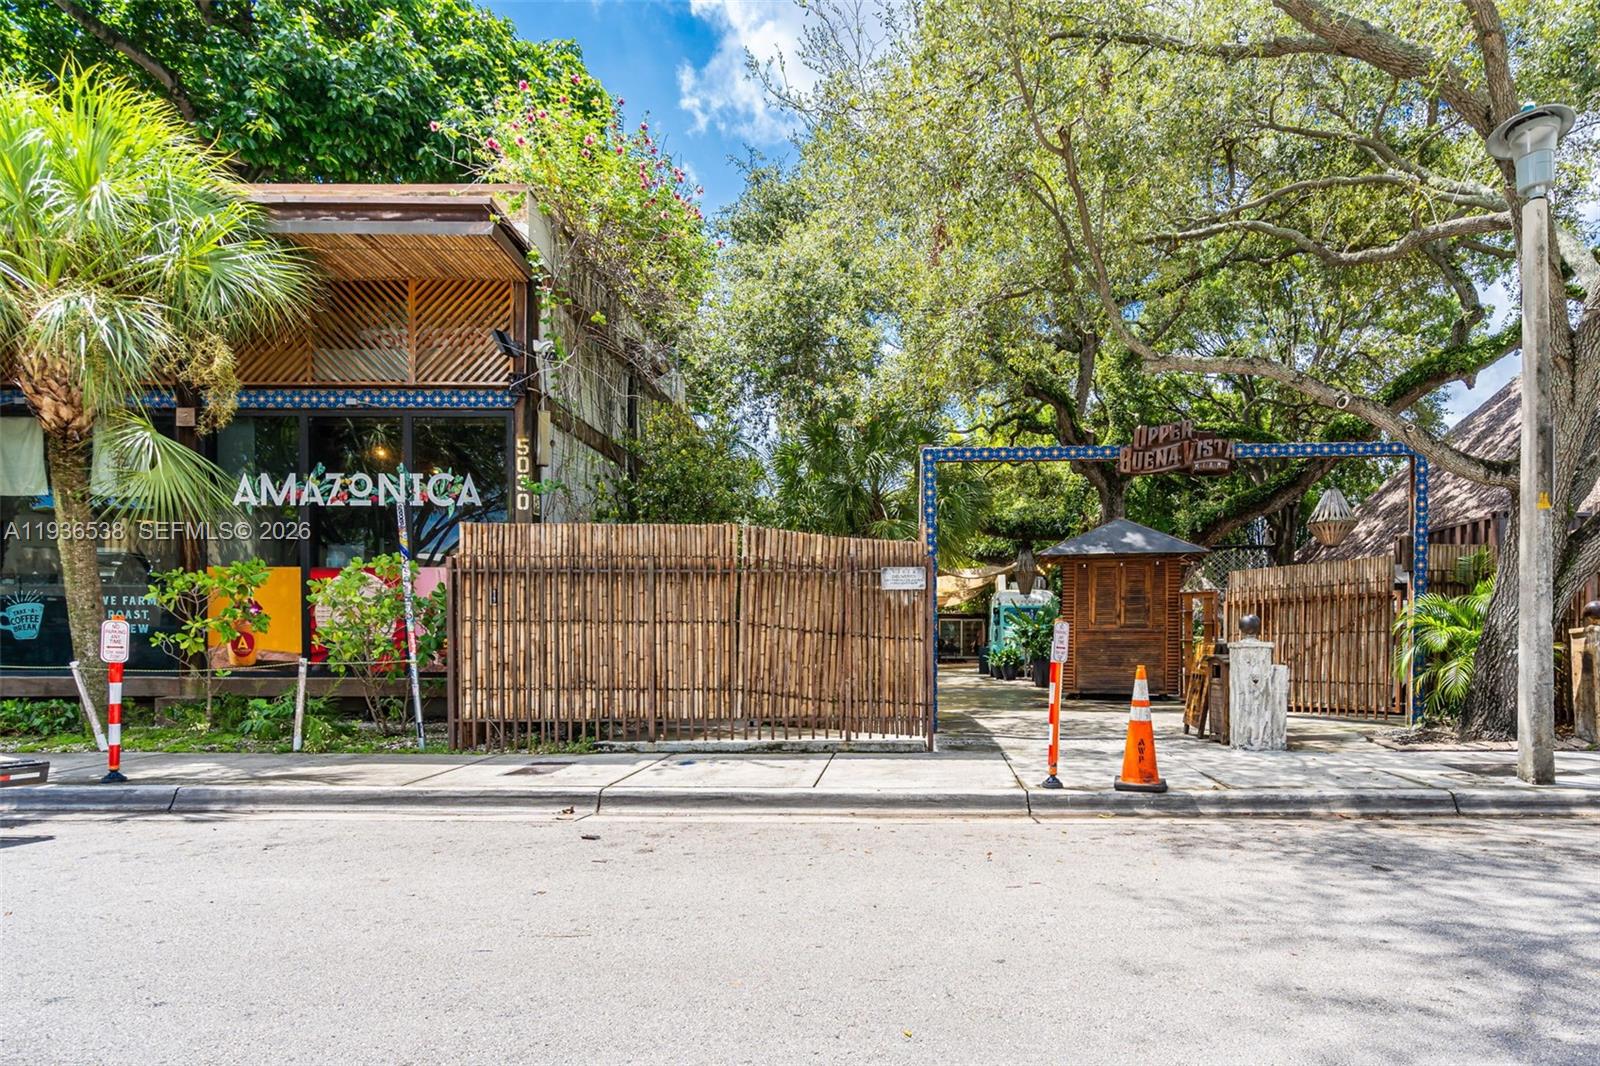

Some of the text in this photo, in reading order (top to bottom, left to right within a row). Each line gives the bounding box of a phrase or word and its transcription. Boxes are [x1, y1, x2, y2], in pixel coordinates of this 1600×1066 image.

[1134, 420, 1193, 449] UPPER
[1120, 439, 1236, 473] BUENA VISTA
[232, 472, 482, 506] AMAZONICA
[10, 614, 40, 625] COFFEE
[13, 623, 37, 632] BREAK
[237, 635, 248, 648] A
